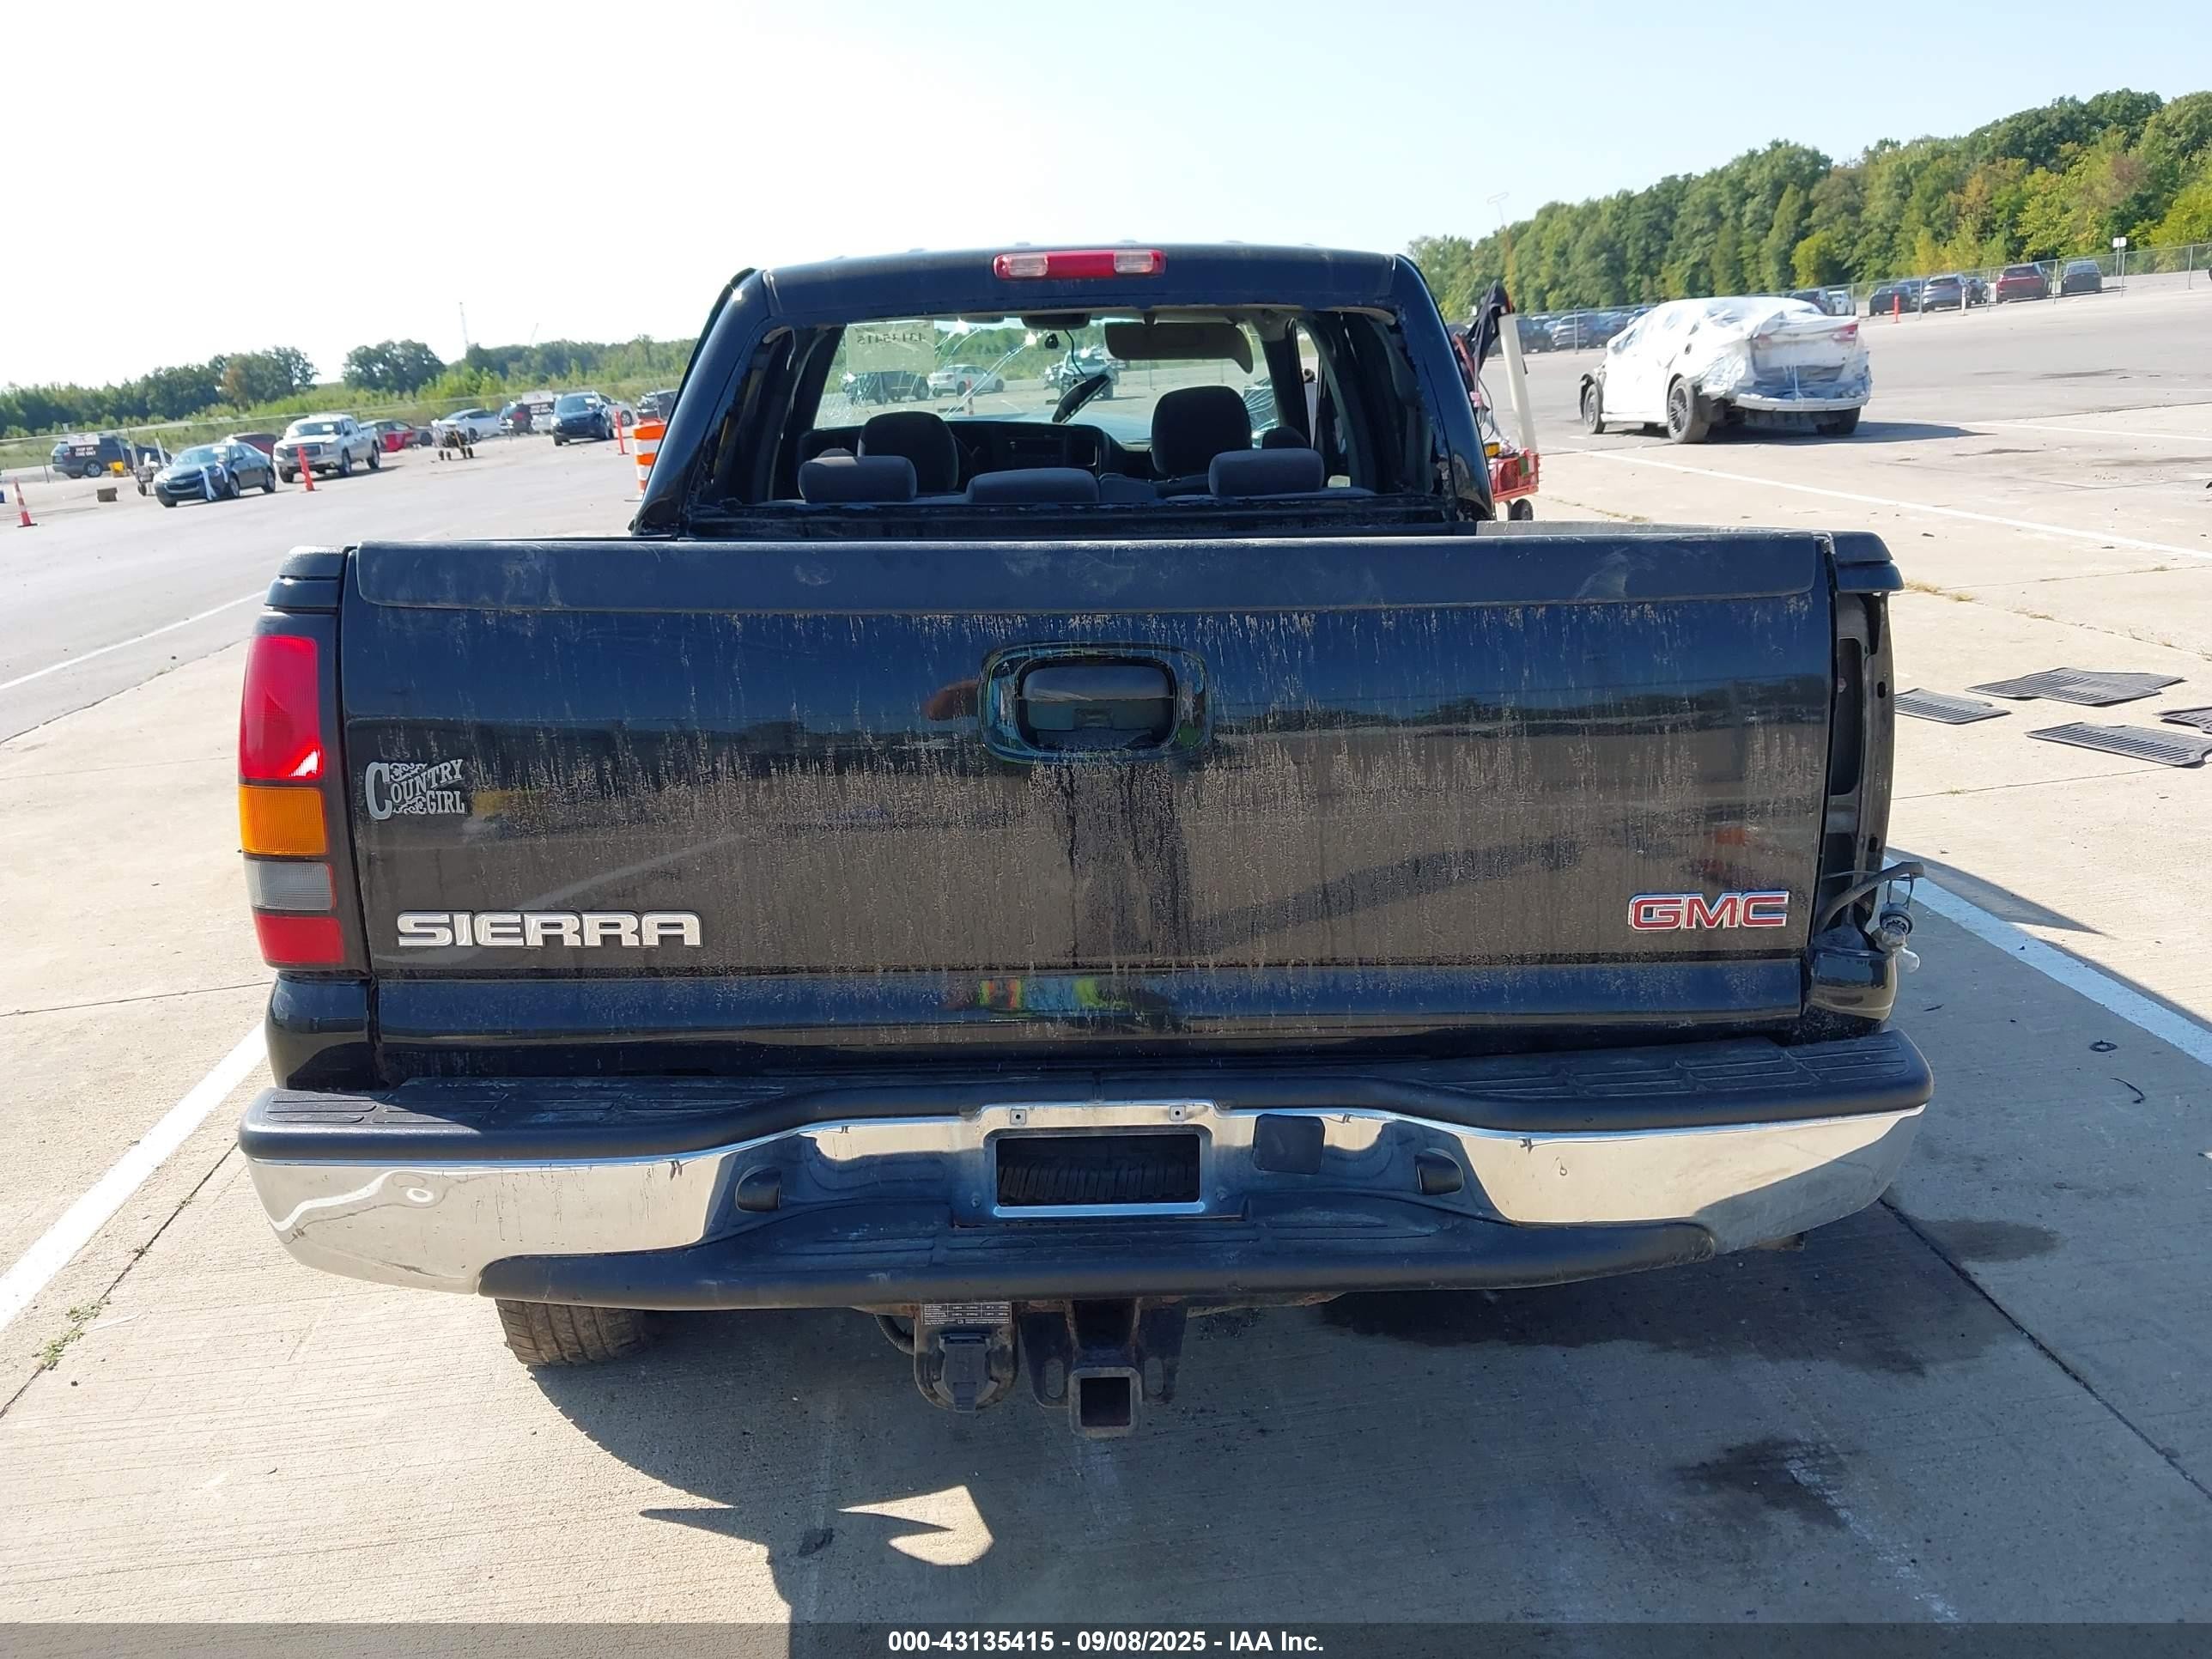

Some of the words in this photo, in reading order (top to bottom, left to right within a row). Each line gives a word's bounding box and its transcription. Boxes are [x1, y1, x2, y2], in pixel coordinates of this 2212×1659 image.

[365, 758, 464, 820] COUNTRY
[426, 790, 466, 815] GIRL
[397, 910, 702, 948] SIERRA
[1628, 890, 1790, 931] GMC
